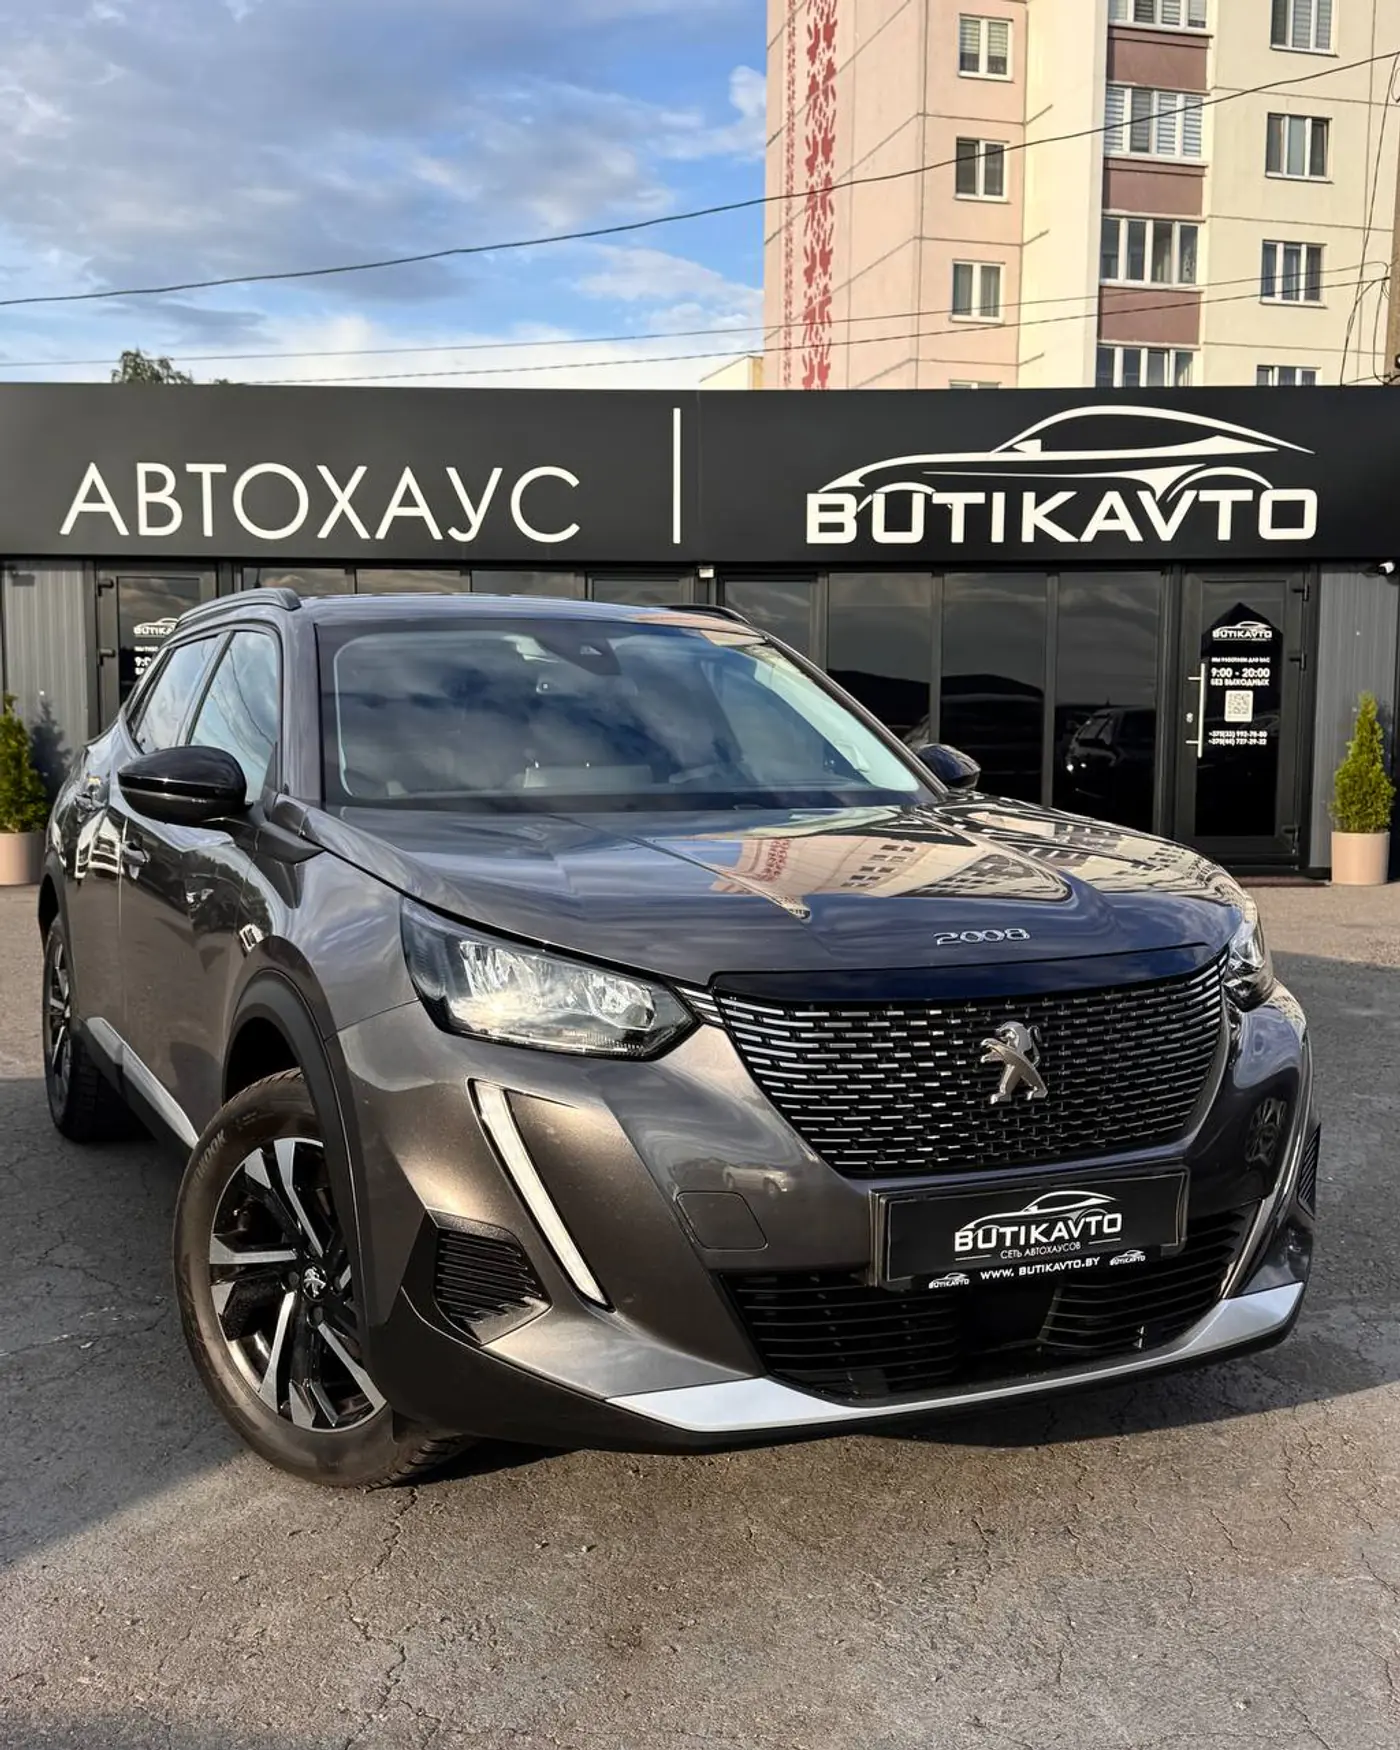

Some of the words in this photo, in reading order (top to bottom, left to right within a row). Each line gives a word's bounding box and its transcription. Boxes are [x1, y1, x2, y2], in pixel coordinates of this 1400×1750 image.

[59, 461, 581, 544] АВТОХАУС
[806, 487, 1318, 545] BUTIKAVTO
[1212, 630, 1273, 639] BUTIKAVTO
[1211, 667, 1233, 678] 9:00
[1241, 667, 1270, 678] 20:00
[933, 928, 1031, 946] 2008
[954, 1213, 1122, 1252] BUTIKAVTO
[1000, 1249, 1022, 1259] СЕТЬ
[1024, 1241, 1081, 1257] АВТОХАУСОВ
[980, 1269, 1014, 1280] WWW.
[1018, 1256, 1100, 1276] BUTIKAVTO.BY
[929, 1278, 970, 1289] BUTIKAVTO
